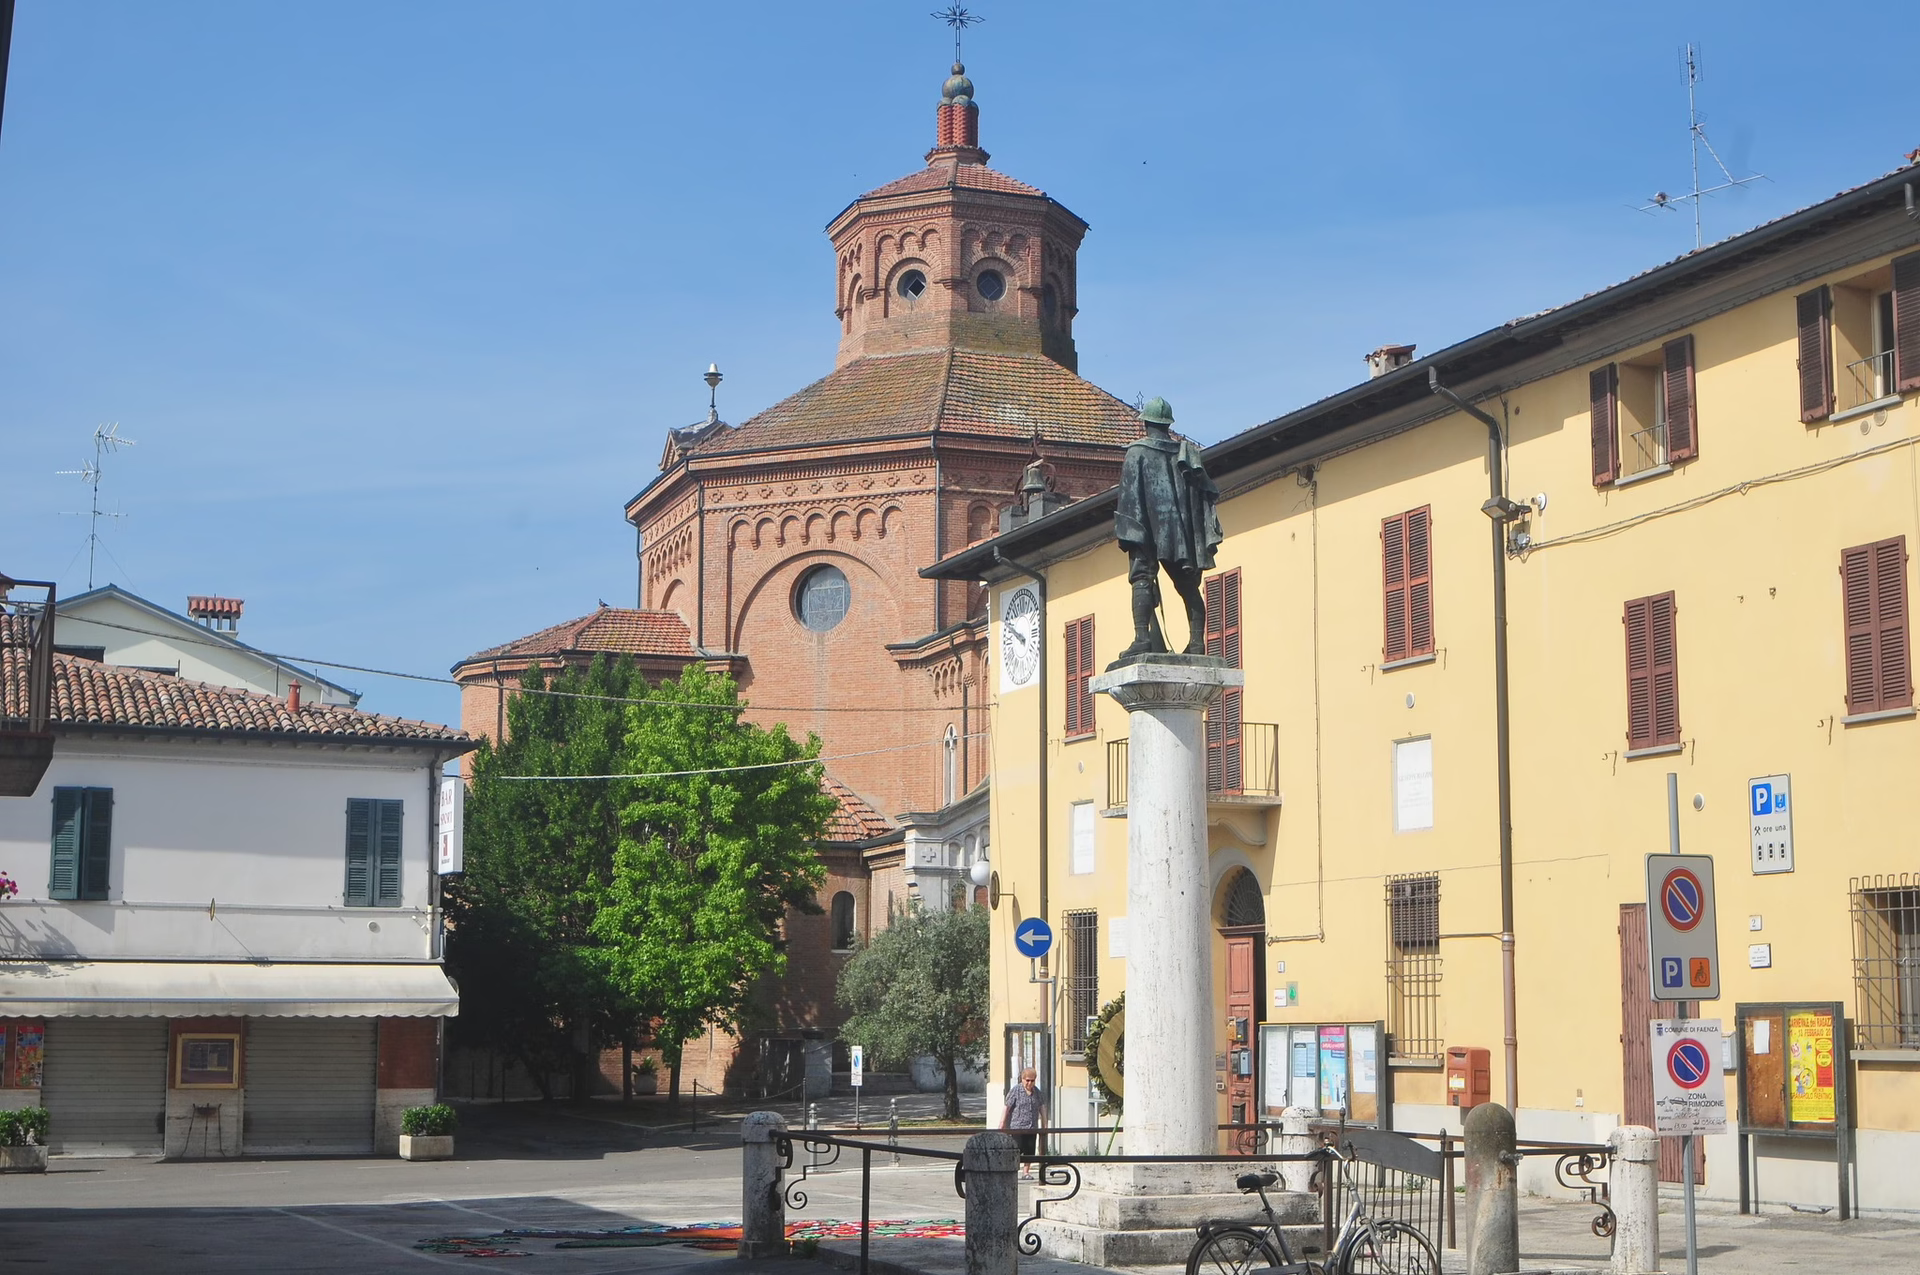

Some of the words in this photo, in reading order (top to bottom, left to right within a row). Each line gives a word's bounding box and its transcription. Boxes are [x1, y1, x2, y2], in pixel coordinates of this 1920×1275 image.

[441, 789, 453, 807] BAR
[1755, 787, 1769, 812] P
[1774, 824, 1787, 832] una
[1665, 960, 1679, 985] P
[1688, 1092, 1707, 1100] ZONA
[1688, 1100, 1724, 1108] RIMOZIONE
